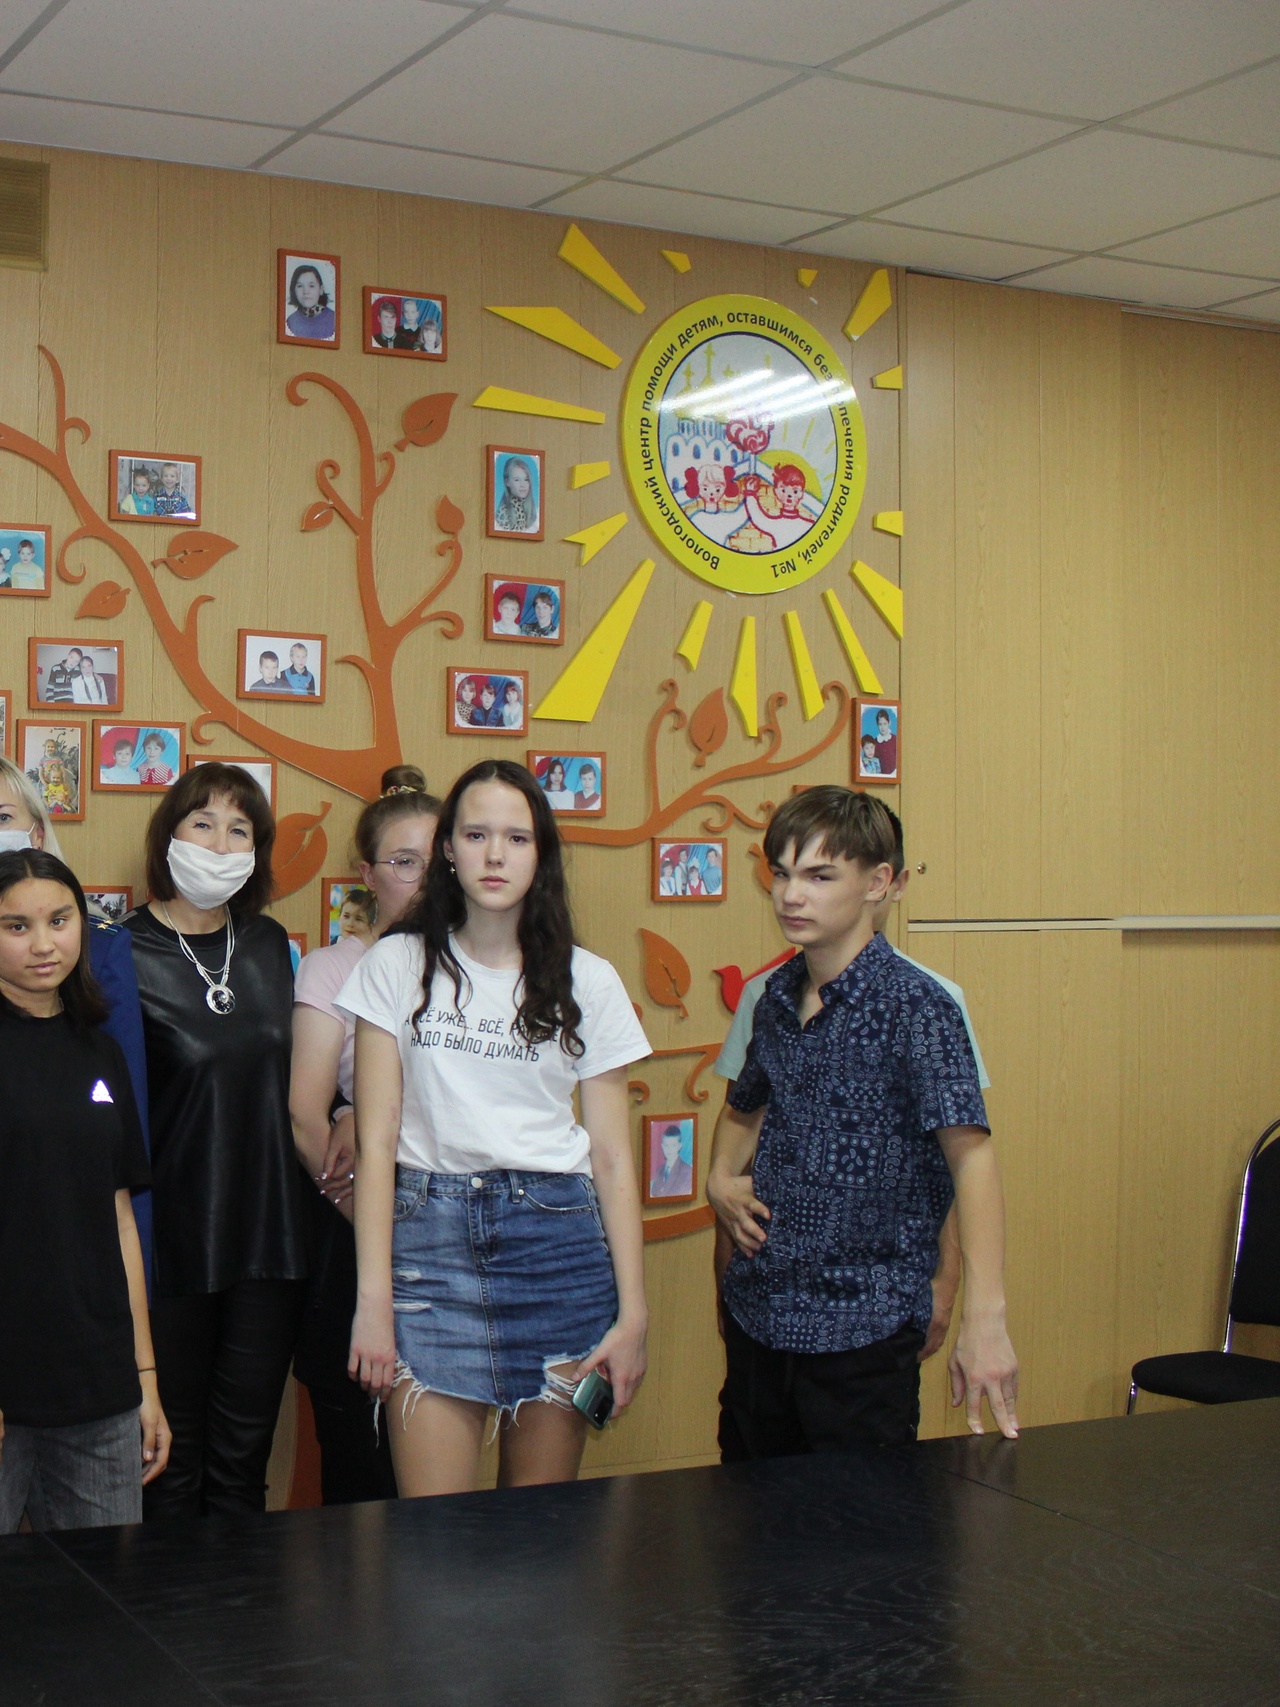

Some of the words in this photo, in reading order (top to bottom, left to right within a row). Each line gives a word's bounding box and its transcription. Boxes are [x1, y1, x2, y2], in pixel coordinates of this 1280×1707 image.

[677, 313, 724, 350] детям,
[726, 311, 813, 355] оставшимся
[642, 343, 678, 412] помощи
[813, 353, 833, 382] без
[639, 416, 655, 472] центр
[643, 476, 720, 571] Вологодский
[794, 485, 851, 566] родителей,
[770, 557, 798, 579] №1
[410, 1031, 441, 1049] НАДО
[443, 1033, 482, 1055] БЫЛО
[483, 1041, 540, 1063] ДУМАТЬ
[477, 1017, 504, 1038] ВСЁ,
